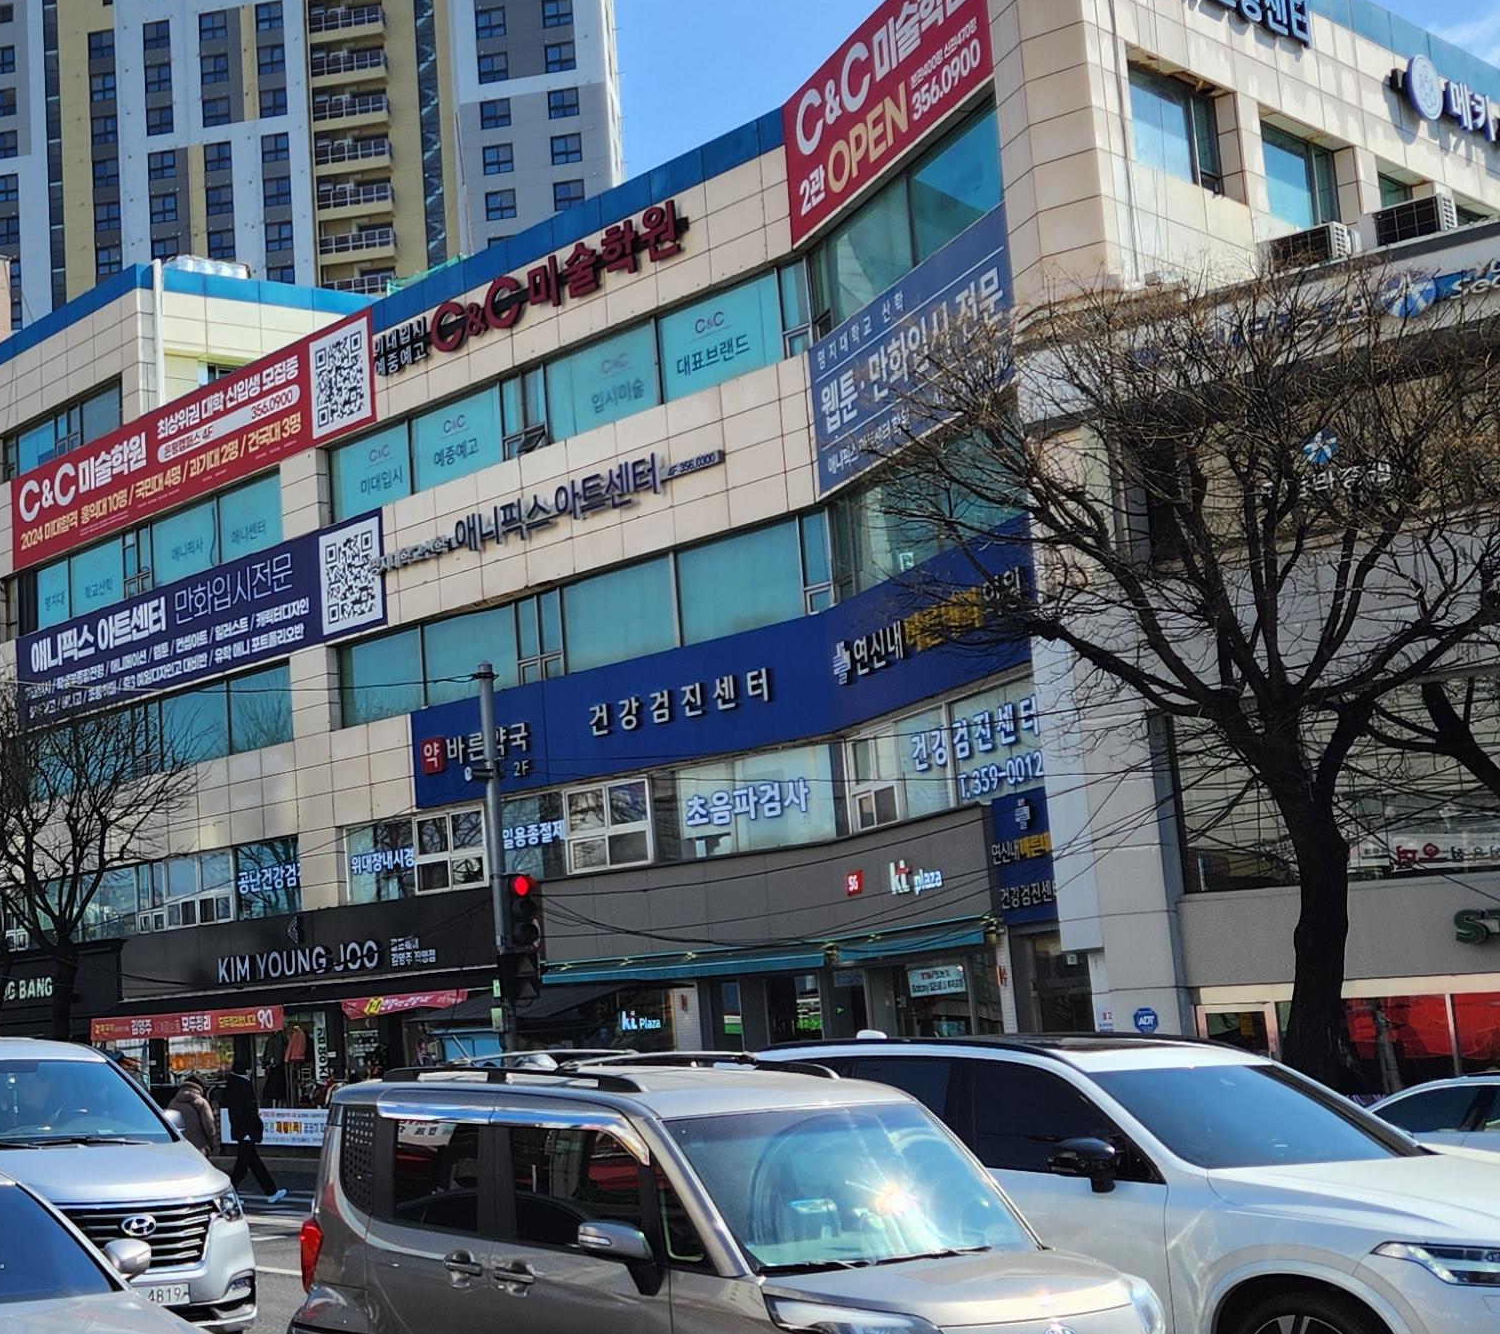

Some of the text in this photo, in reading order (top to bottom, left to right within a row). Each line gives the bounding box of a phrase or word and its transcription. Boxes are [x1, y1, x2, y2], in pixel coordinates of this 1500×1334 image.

[912, 38, 981, 121] 356.0900
[827, 82, 909, 194] OPEN
[676, 333, 750, 377] 대표브랜드
[31, 552, 294, 673] 애니픽스 아트센터 만화입시전문
[589, 667, 769, 736] 건강검진센터
[911, 694, 1041, 773] 건강검진센터
[685, 778, 810, 828] 초음파검사
[19, 977, 53, 999] BANG
[217, 939, 379, 984] KIM YOUNG JOO
[1138, 1013, 1156, 1028] ADT
